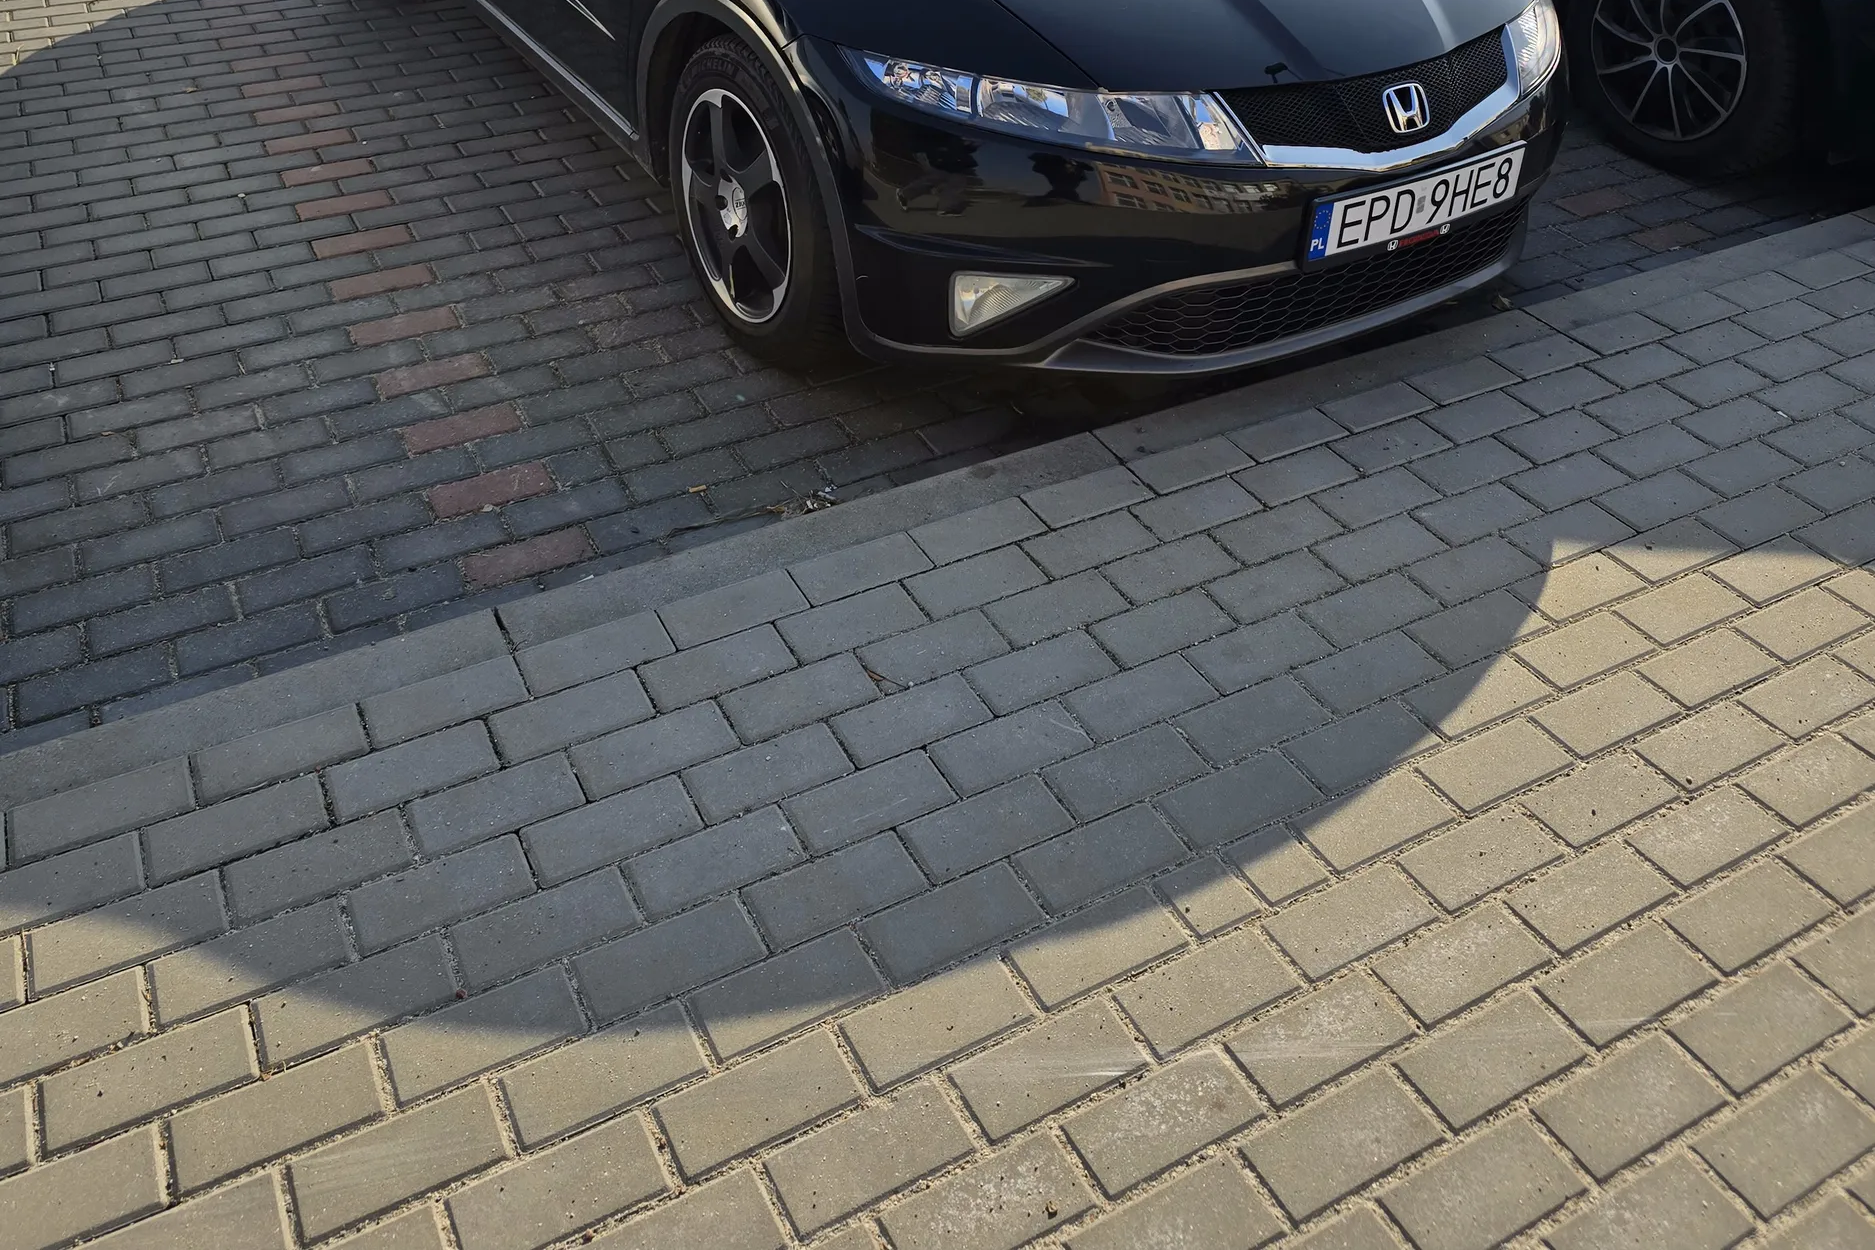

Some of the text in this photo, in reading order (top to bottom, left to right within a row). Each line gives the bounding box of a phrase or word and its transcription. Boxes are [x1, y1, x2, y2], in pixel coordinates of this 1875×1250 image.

[1336, 157, 1513, 249] EPD 9HE8
[1310, 238, 1325, 252] PL
